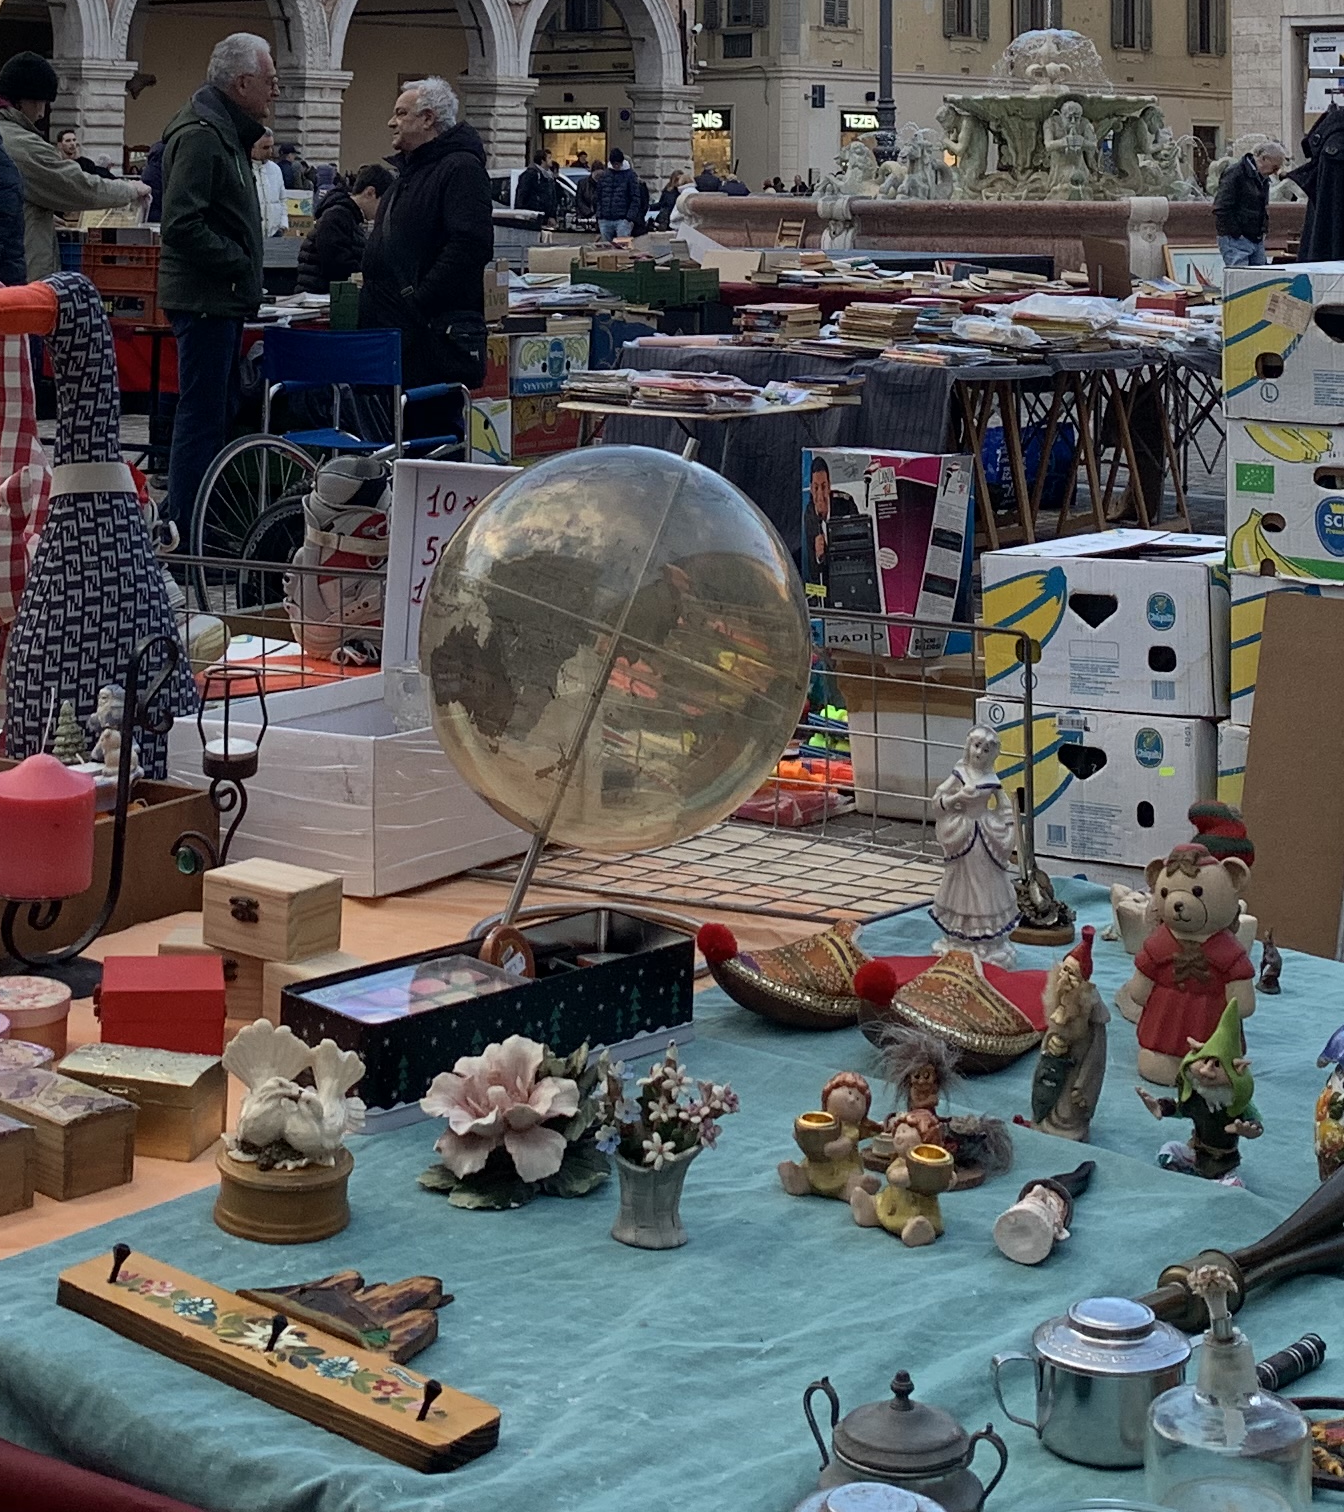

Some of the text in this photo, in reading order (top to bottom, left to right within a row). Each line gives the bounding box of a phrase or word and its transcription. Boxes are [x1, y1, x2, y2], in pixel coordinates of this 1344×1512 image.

[692, 111, 723, 129] ENIS
[843, 113, 879, 129] TEZEN
[828, 633, 884, 643] RADIO
